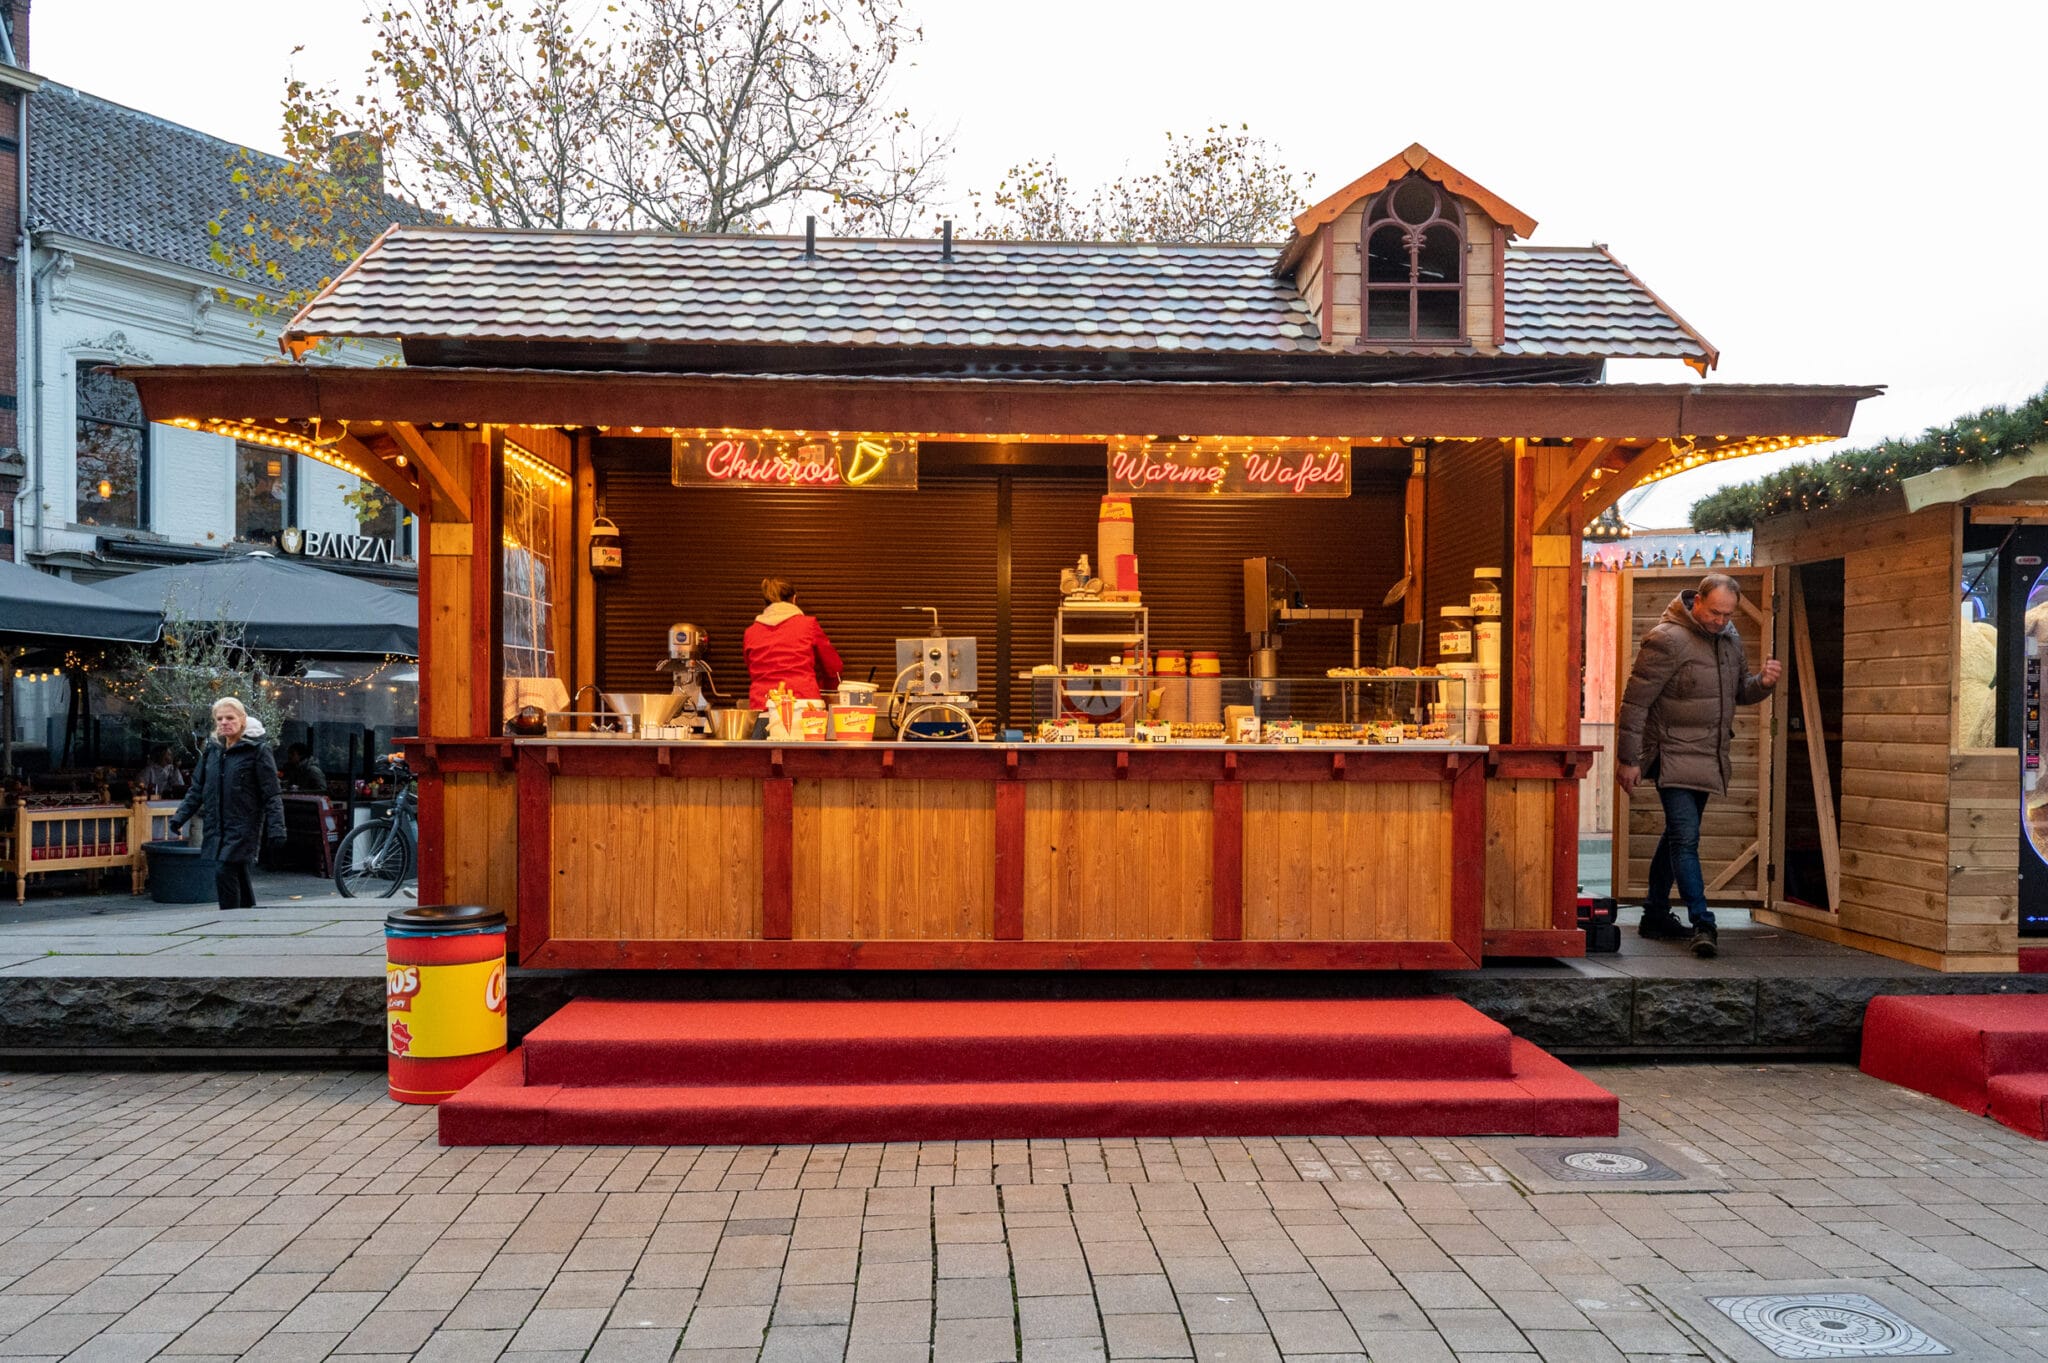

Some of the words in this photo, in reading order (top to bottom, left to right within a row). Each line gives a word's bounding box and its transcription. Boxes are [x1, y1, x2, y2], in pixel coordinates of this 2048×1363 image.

[706, 440, 840, 482] Churros
[1113, 452, 1223, 482] Warme
[1245, 452, 1345, 493] Wafels
[305, 530, 394, 564] BANZAI
